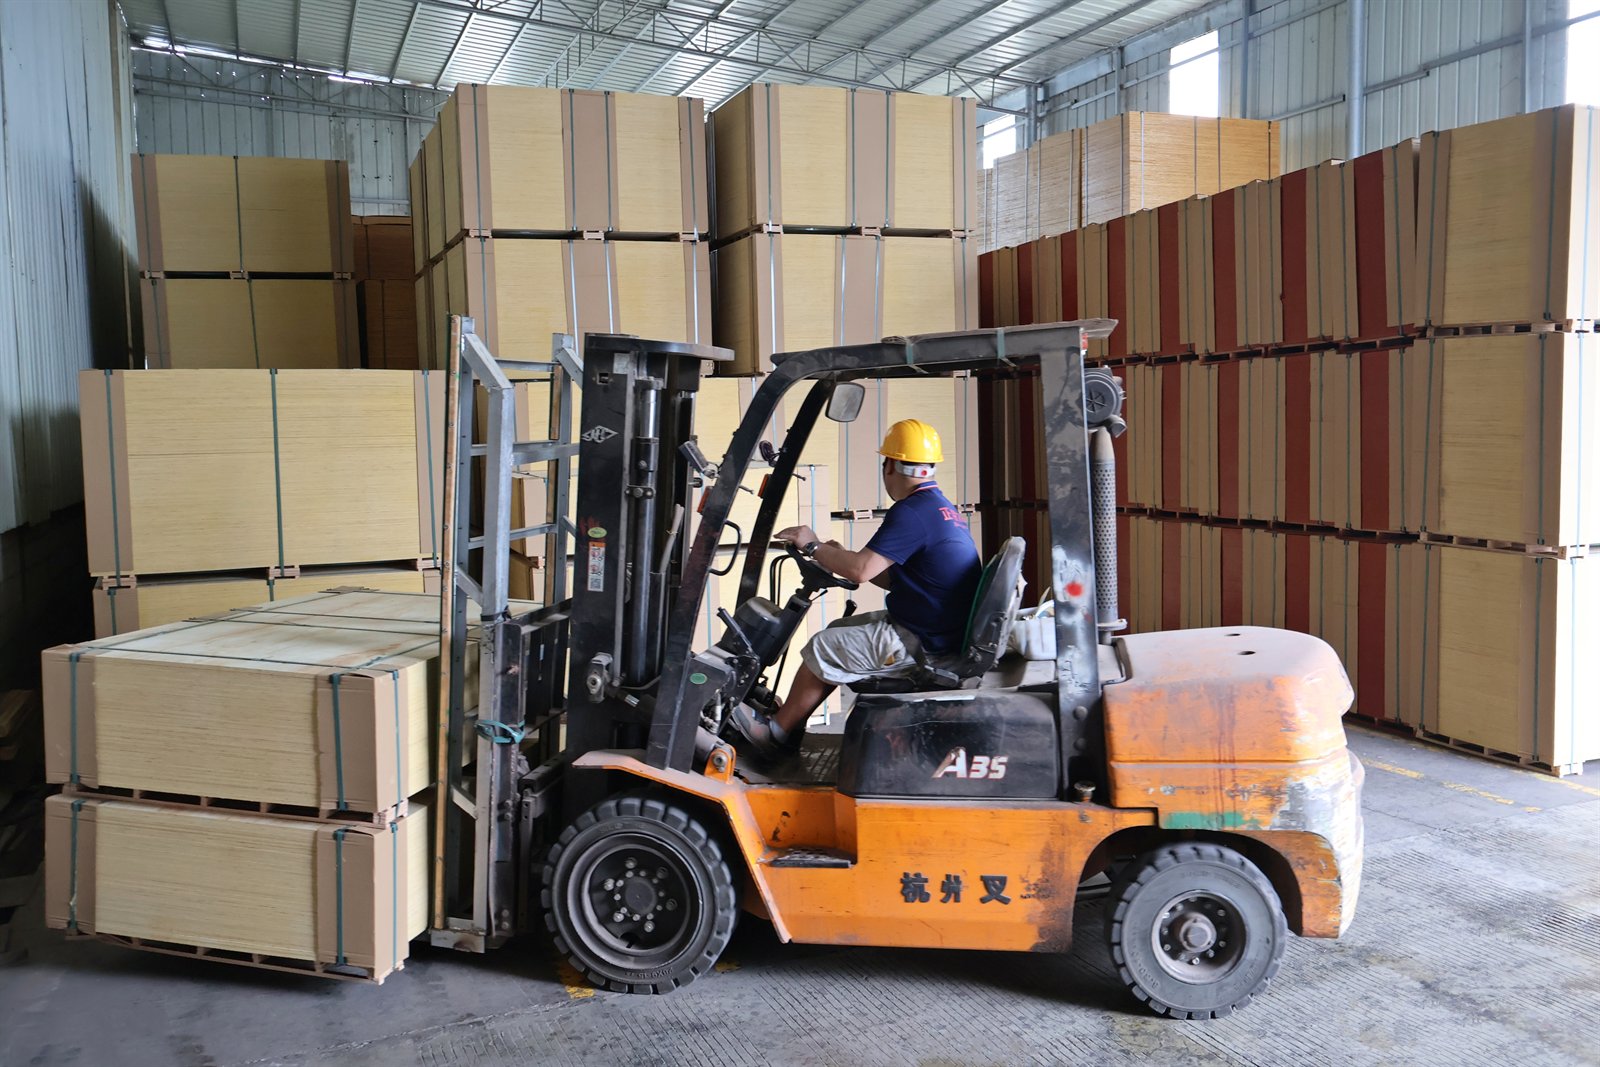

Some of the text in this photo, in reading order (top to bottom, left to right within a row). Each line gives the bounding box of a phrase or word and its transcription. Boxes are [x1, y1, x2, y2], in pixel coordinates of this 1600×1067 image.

[932, 747, 1008, 779] A35
[900, 872, 1049, 905] 杭州叉
